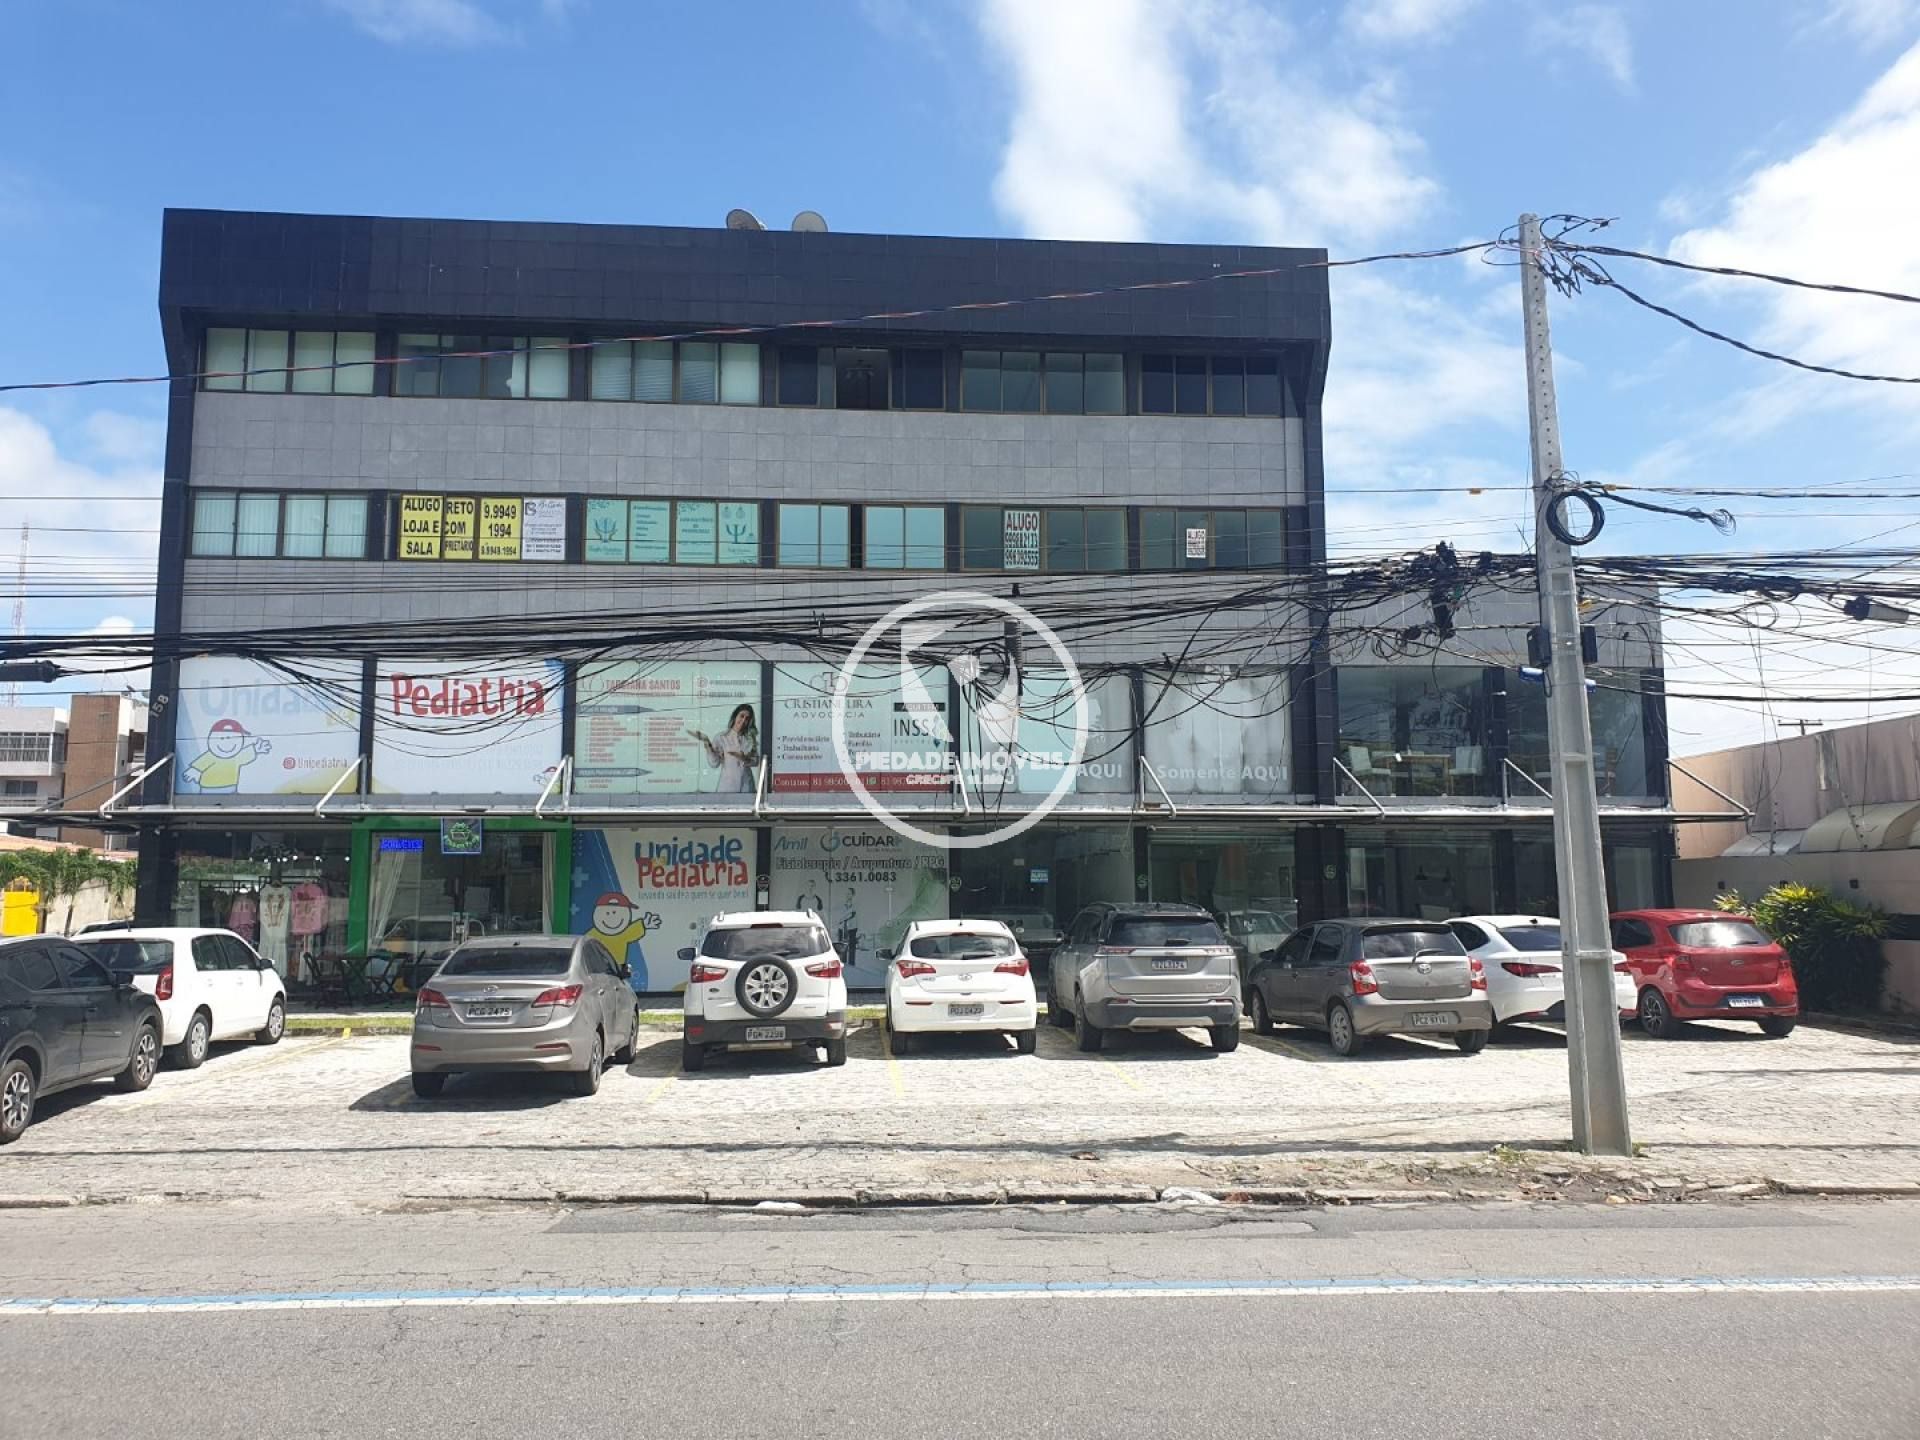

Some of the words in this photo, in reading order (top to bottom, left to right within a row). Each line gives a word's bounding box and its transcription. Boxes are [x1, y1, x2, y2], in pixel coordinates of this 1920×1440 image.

[404, 498, 440, 511] ALUGO
[484, 505, 516, 519] 9.9949
[403, 520, 429, 533] LOJA
[432, 520, 439, 533] E
[443, 522, 466, 535] COM
[1006, 512, 1037, 531] ALUGO
[488, 523, 511, 537] 1994
[406, 541, 432, 555] SALA
[390, 672, 545, 716] Pediatria
[150, 695, 168, 717] 158
[894, 719, 928, 737] INSS
[1077, 764, 1122, 779] AQUI
[1156, 765, 1236, 780] Somente
[1241, 765, 1288, 780] AQUI
[635, 835, 742, 866] Unidade
[636, 857, 748, 889] Pediatria
[835, 872, 897, 882] 3361.0083
